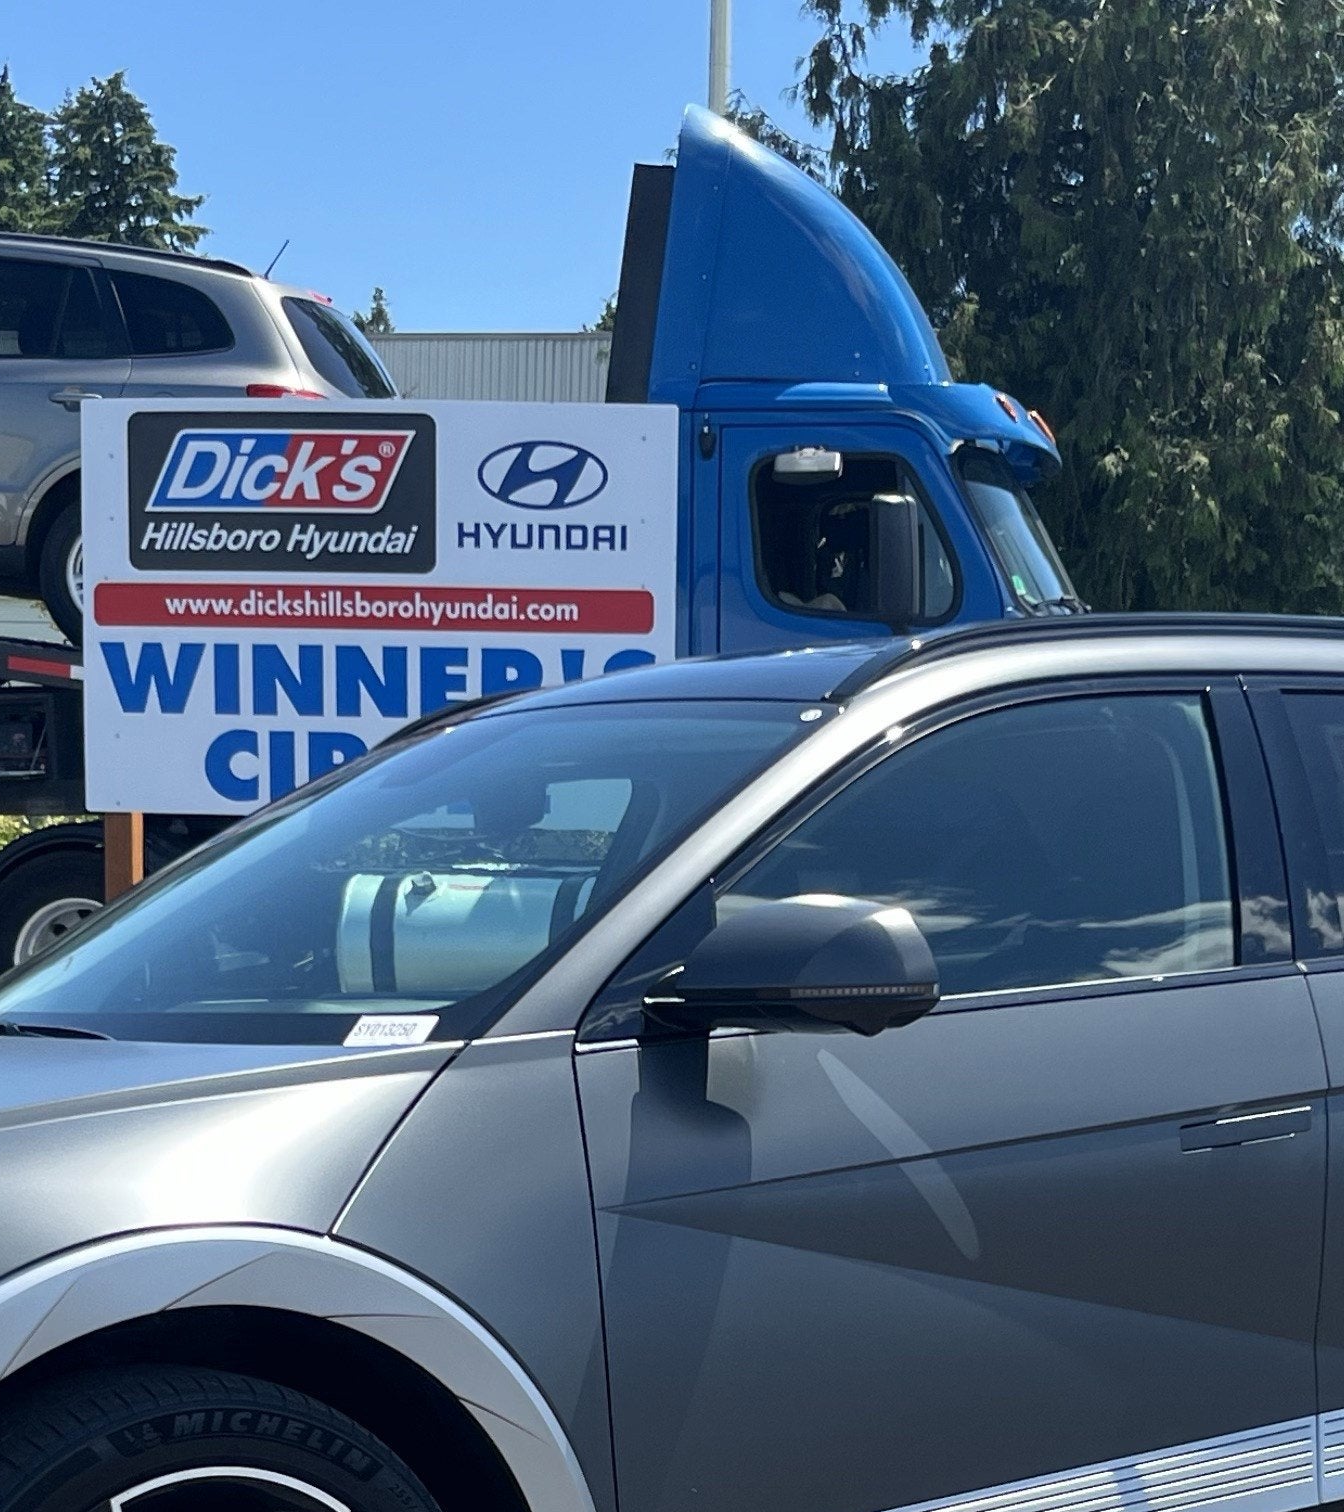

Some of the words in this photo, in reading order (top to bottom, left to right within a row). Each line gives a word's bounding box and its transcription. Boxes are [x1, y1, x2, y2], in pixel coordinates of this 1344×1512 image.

[166, 438, 382, 502] Dick's
[140, 521, 282, 553] Hillsboro
[286, 523, 419, 560] Hyundai
[457, 522, 628, 552] HYUNDAI
[165, 589, 579, 624] www.dickshillsborohyundai.com
[173, 1409, 372, 1473] MICHELIN
